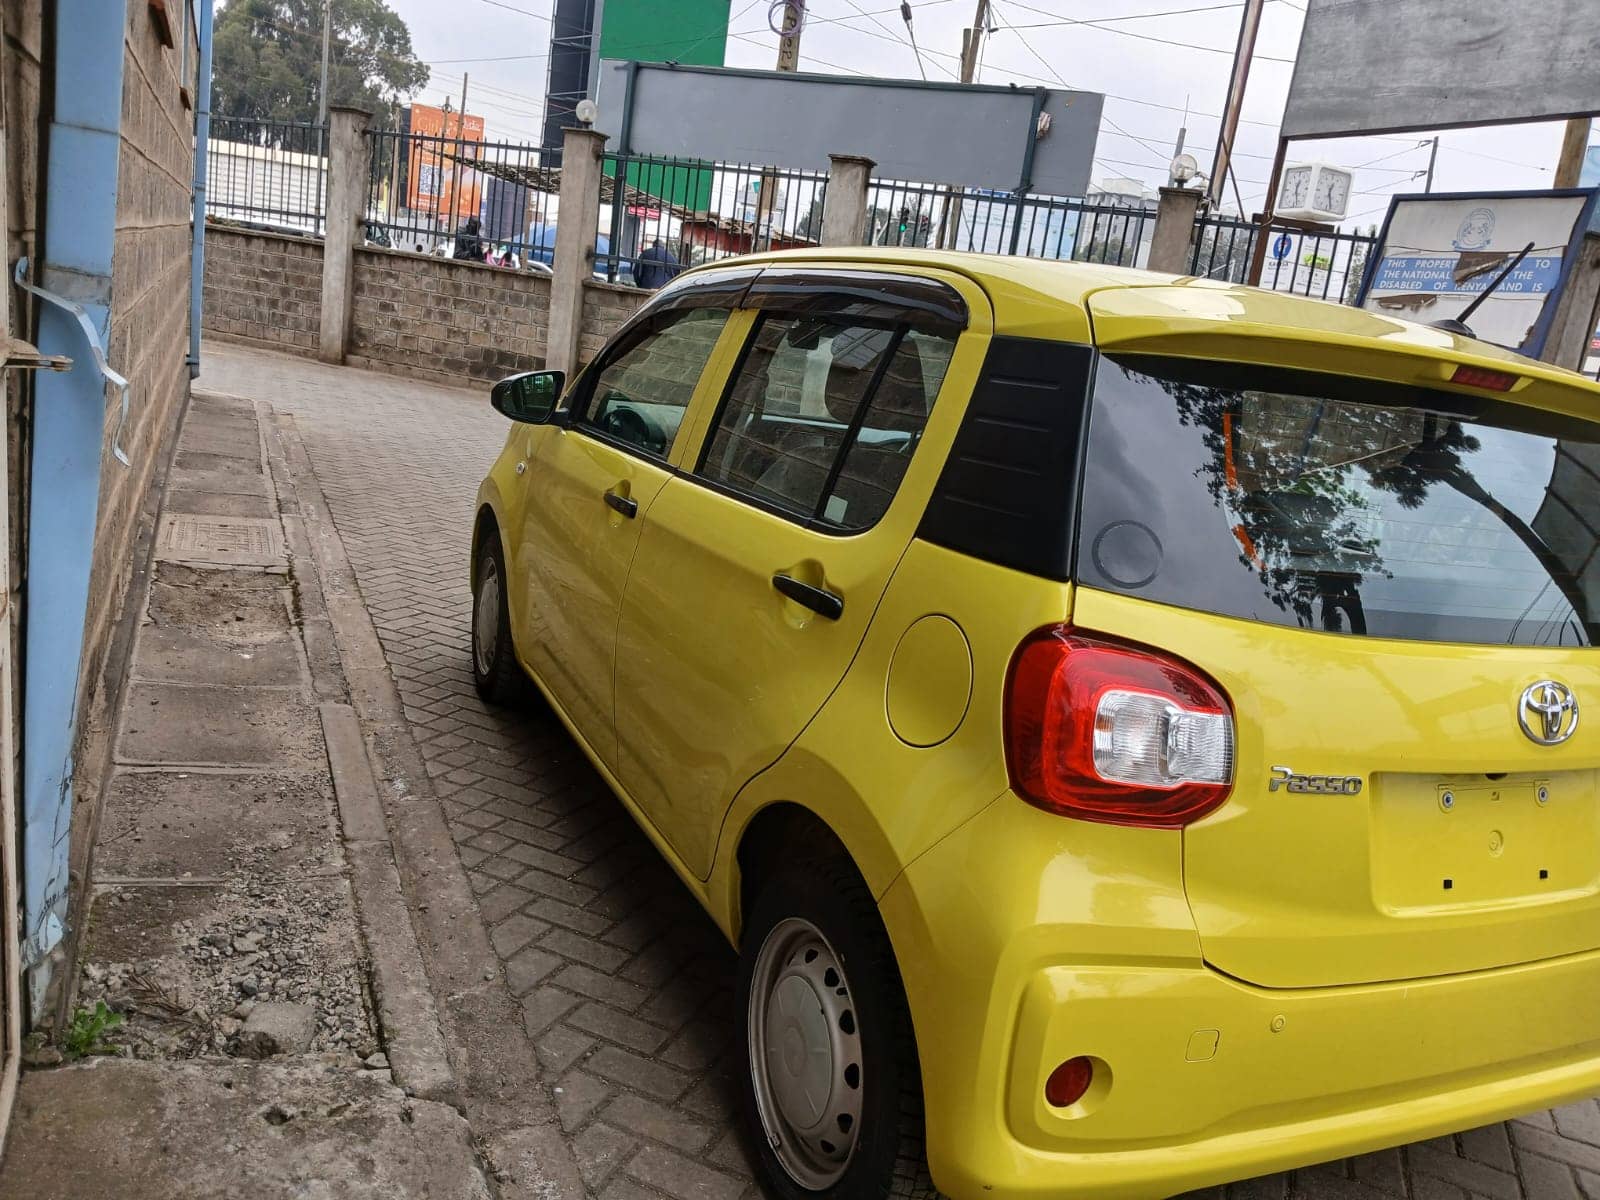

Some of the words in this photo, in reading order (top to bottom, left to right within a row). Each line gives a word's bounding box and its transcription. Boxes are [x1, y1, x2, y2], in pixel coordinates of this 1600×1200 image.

[1387, 259, 1406, 269] THIS
[1415, 259, 1457, 270] PROPERT
[1535, 259, 1551, 269] TO
[1383, 270, 1401, 279] THE
[1401, 270, 1450, 280] NATIONAL
[1514, 271, 1534, 280] THE
[1379, 280, 1423, 290] DISABLED
[1433, 282, 1447, 290] OF
[1499, 282, 1523, 292] AND
[1532, 283, 1543, 292] IS
[1269, 765, 1363, 796] Passo
